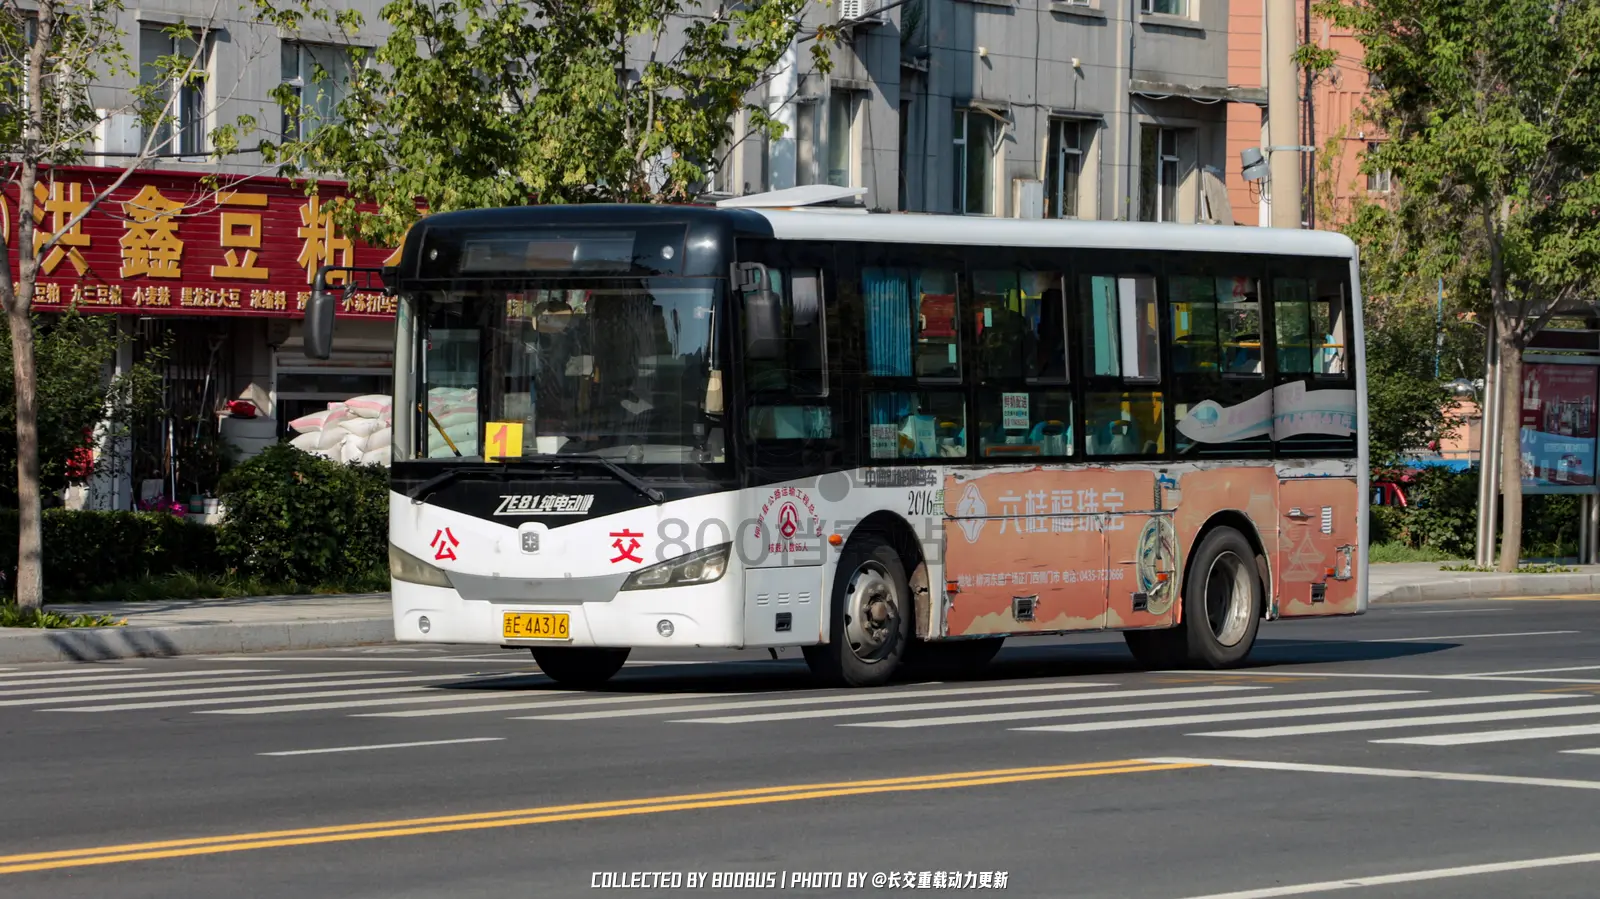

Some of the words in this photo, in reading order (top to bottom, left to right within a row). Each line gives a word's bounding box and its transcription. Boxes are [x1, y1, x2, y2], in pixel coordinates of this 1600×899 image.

[33, 181, 418, 285] 洪鑫豆粕
[180, 287, 241, 308] 黑龙江大豆
[250, 289, 287, 310] 浓缩料
[492, 425, 508, 457] 1
[908, 491, 933, 516] 2016
[430, 527, 460, 562] 公
[609, 528, 644, 564] 交
